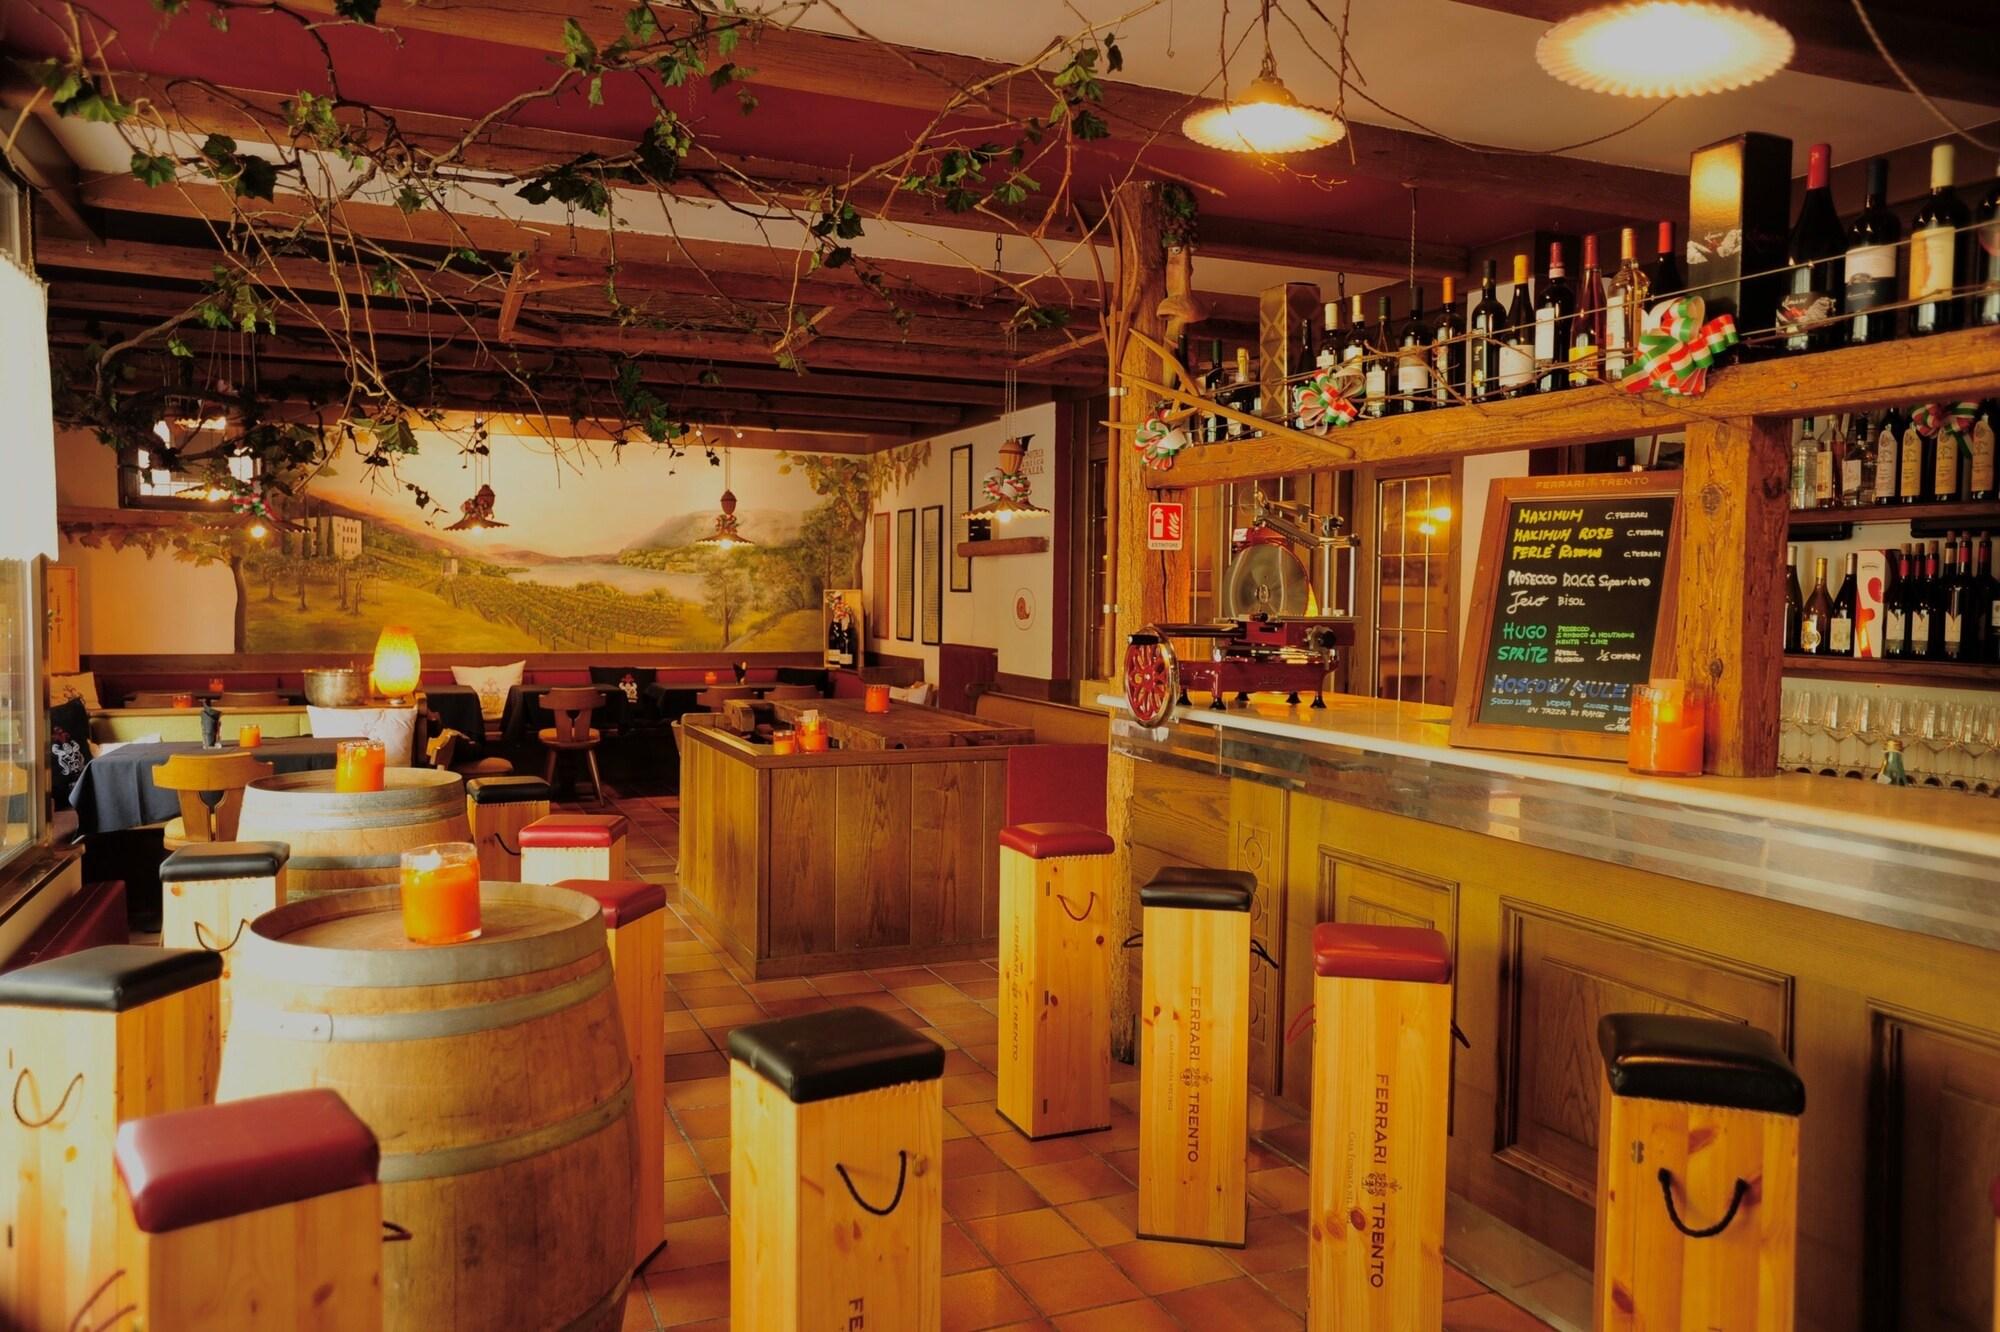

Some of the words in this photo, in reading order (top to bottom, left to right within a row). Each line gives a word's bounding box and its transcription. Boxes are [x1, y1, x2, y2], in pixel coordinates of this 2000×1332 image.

[1536, 480, 1585, 489] FERRARI
[1600, 477, 1649, 487] TRENTO
[1519, 509, 1583, 524] MAXIMUM
[1513, 528, 1572, 542] MAXIMUM
[1507, 569, 1558, 586] PROSECCO
[1598, 575, 1651, 592] Superiore
[1503, 622, 1547, 640] HUGO
[1493, 674, 1571, 693] MOSCOW
[1571, 680, 1630, 698] MULE
[1190, 986, 1201, 1060] FERRARI
[1188, 1092, 1200, 1163] TRENTO
[1375, 1073, 1389, 1164] FERRARI
[1371, 1203, 1386, 1288] TRENTO
